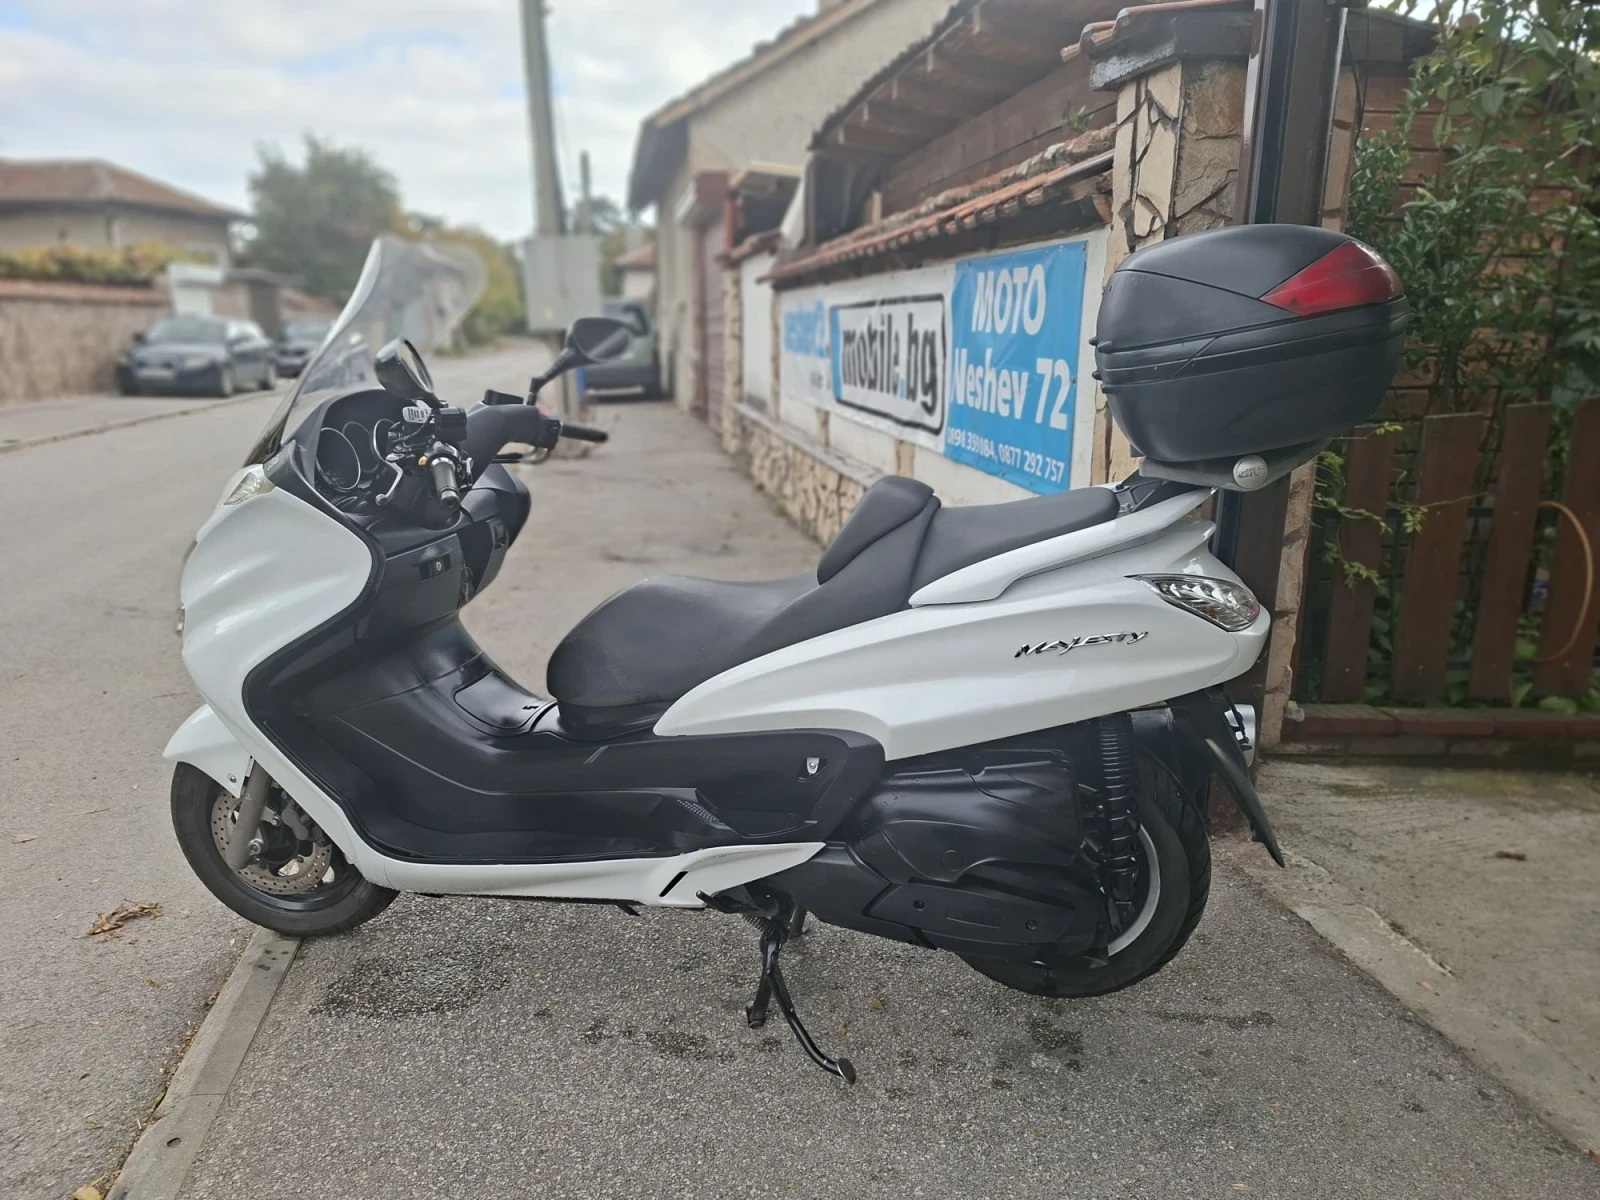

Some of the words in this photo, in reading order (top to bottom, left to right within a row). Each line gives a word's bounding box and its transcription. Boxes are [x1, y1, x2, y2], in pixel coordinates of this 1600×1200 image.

[971, 263, 1047, 335] MOTO
[842, 311, 938, 417] mobile.bg
[951, 347, 1029, 420] Neshev
[1035, 357, 1071, 431] 72
[998, 443, 1022, 468] 0877
[1023, 450, 1043, 477] 292
[1044, 456, 1065, 483] 757
